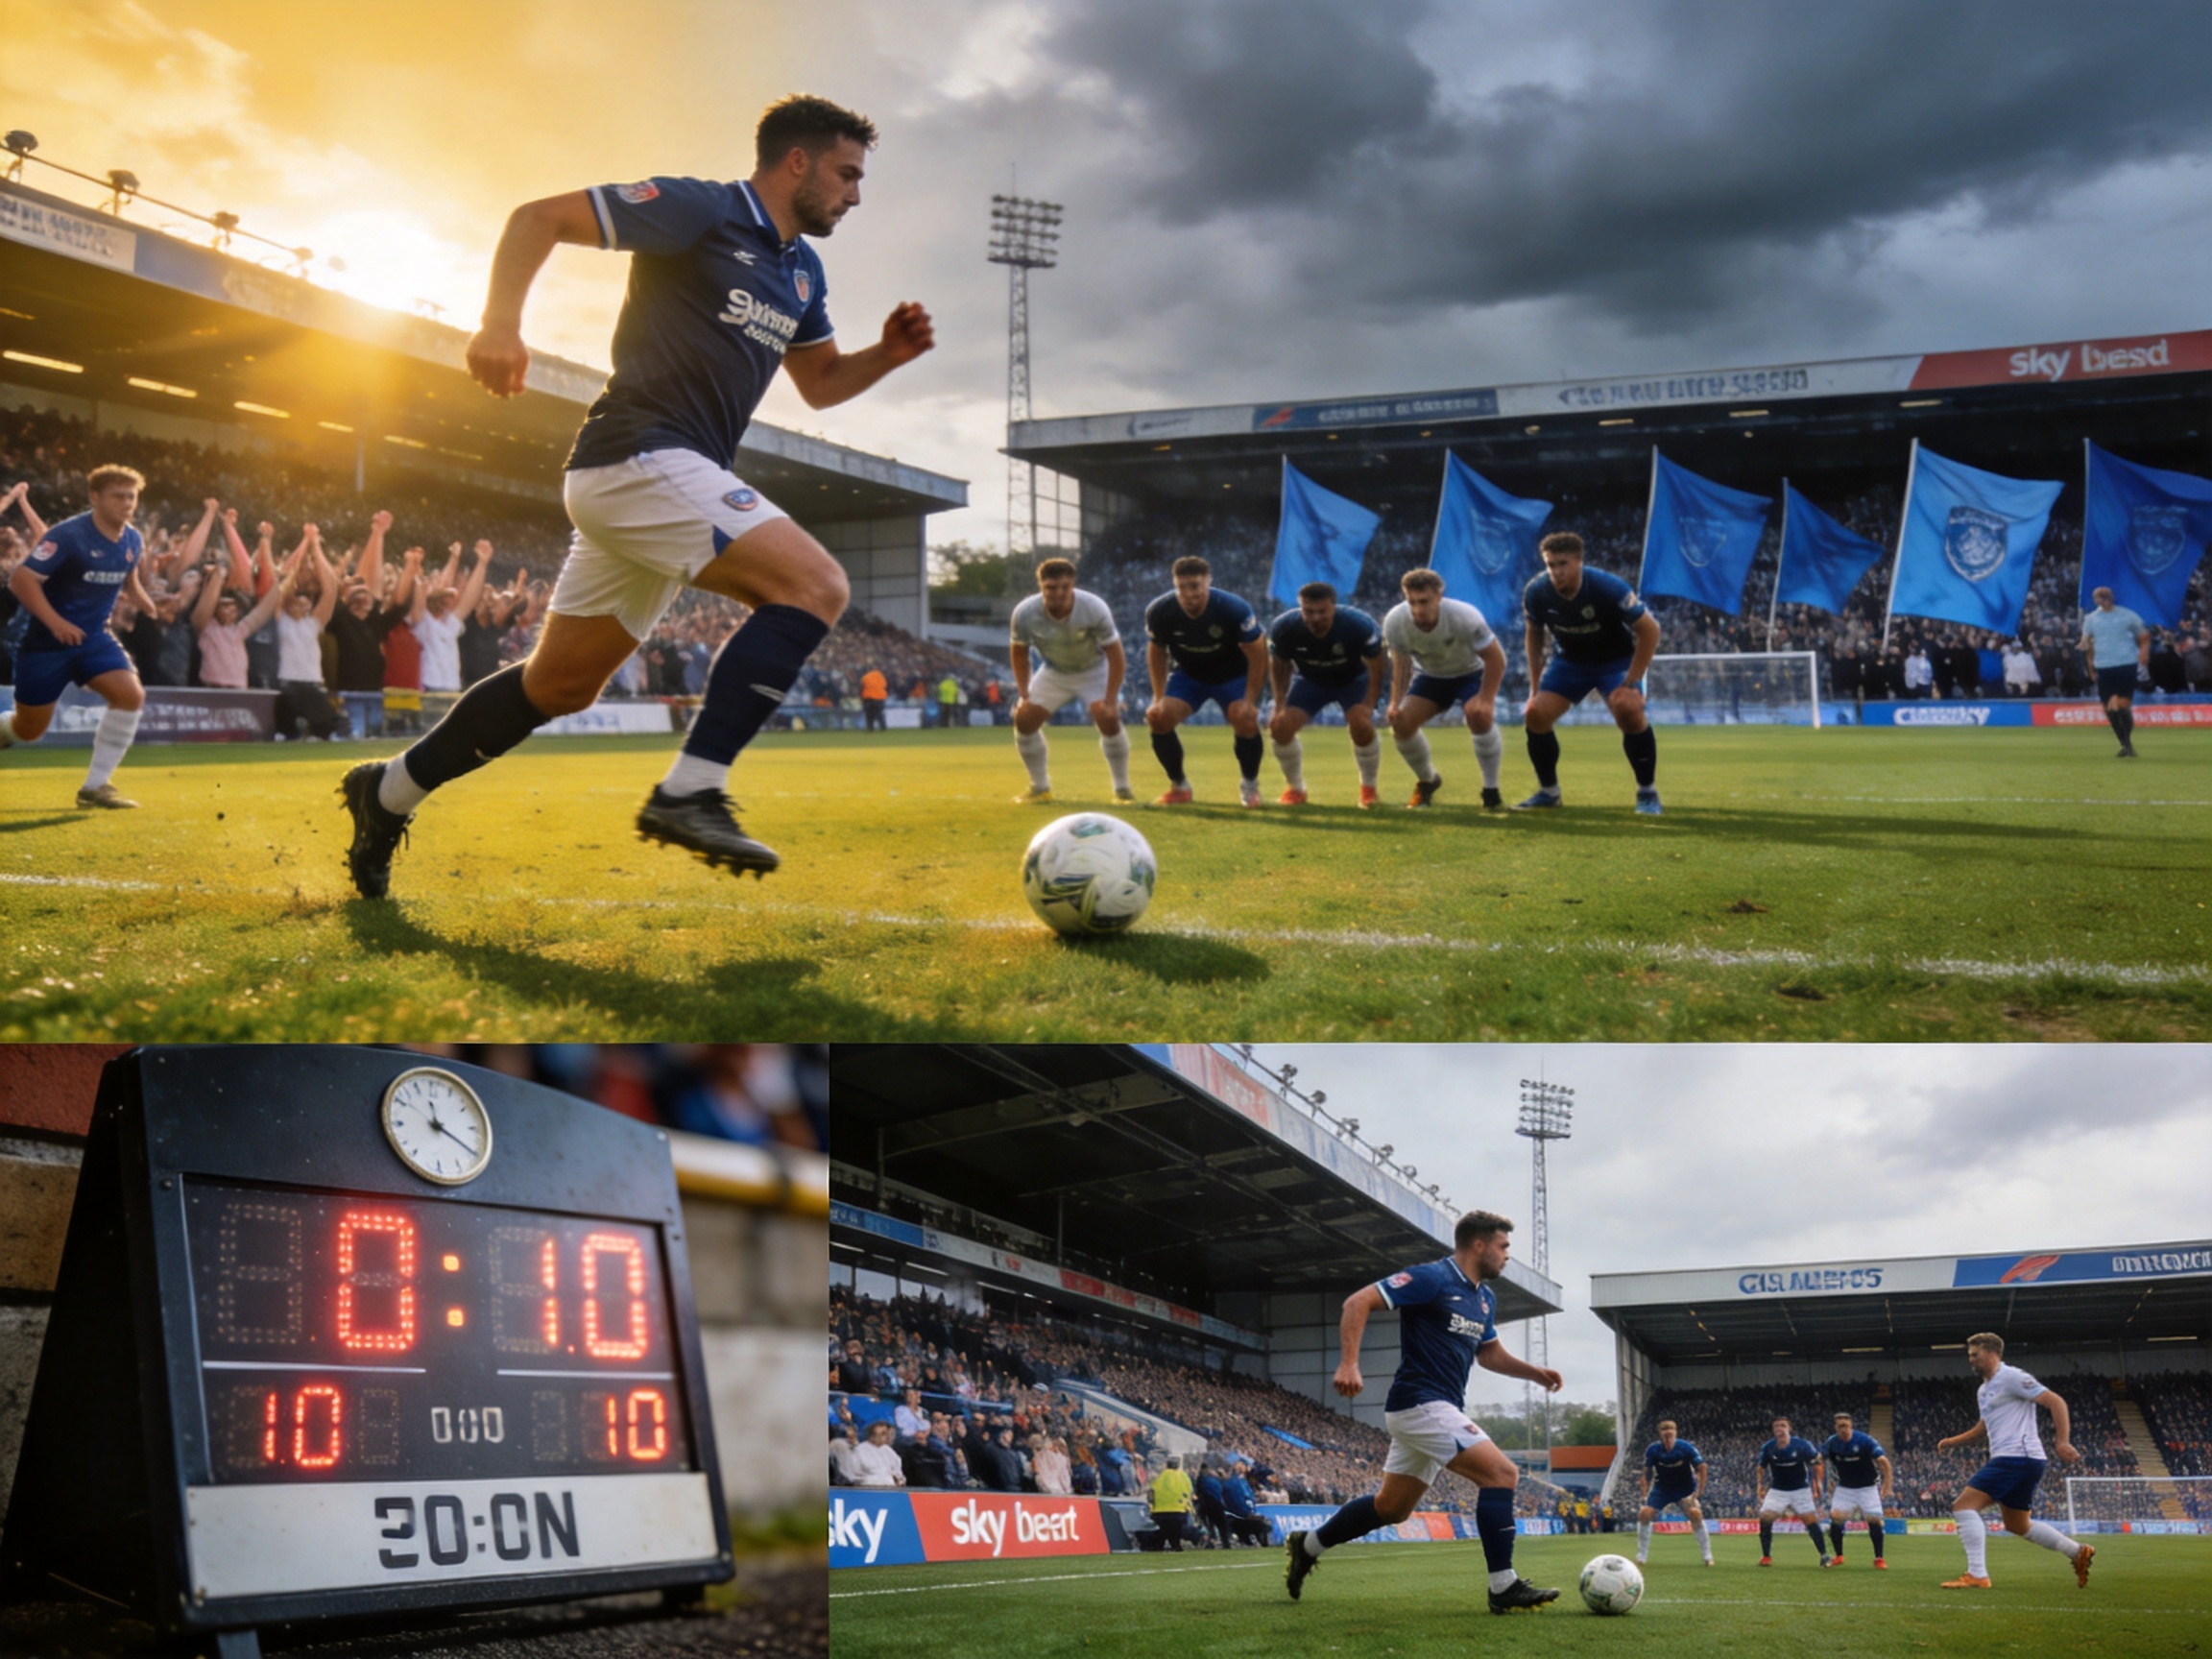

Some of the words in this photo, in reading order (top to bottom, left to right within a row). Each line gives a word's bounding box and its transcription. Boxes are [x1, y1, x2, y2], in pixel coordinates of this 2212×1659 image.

[2009, 347, 2071, 383] sky
[607, 1390, 665, 1460] 10
[950, 1499, 1006, 1557] sky
